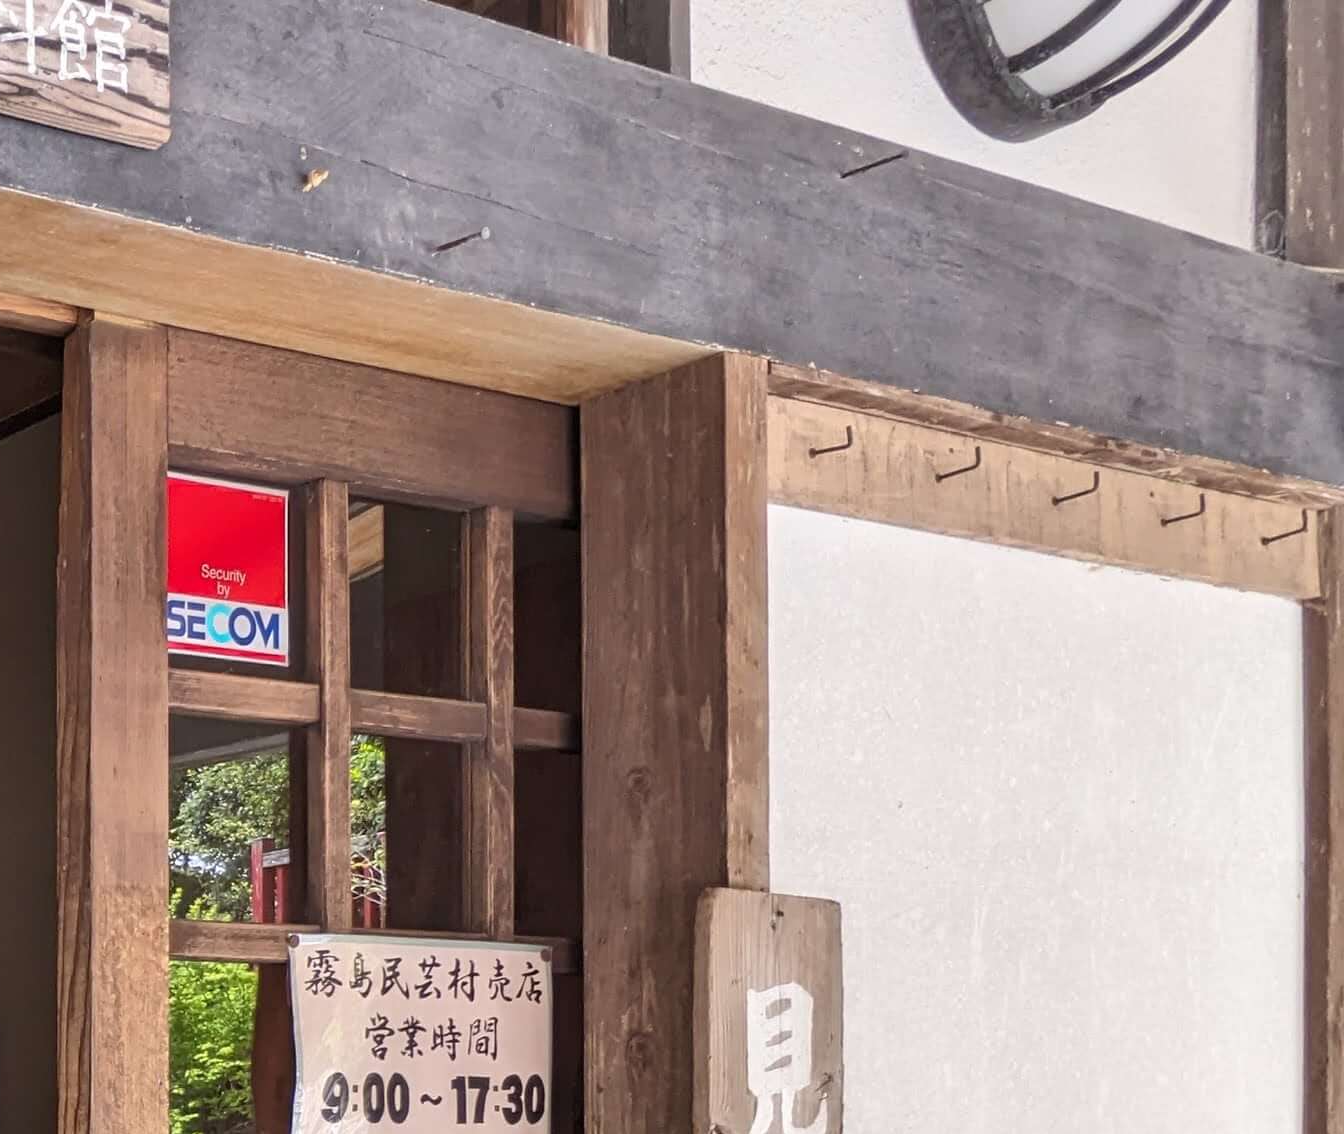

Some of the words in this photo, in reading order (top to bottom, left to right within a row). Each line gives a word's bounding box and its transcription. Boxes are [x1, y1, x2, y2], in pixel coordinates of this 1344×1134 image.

[201, 564, 247, 586] Security
[217, 582, 231, 598] by
[167, 599, 280, 649] SECOM
[303, 950, 545, 1004] 霧島民芸村売店
[364, 1013, 499, 1061] 営業時間
